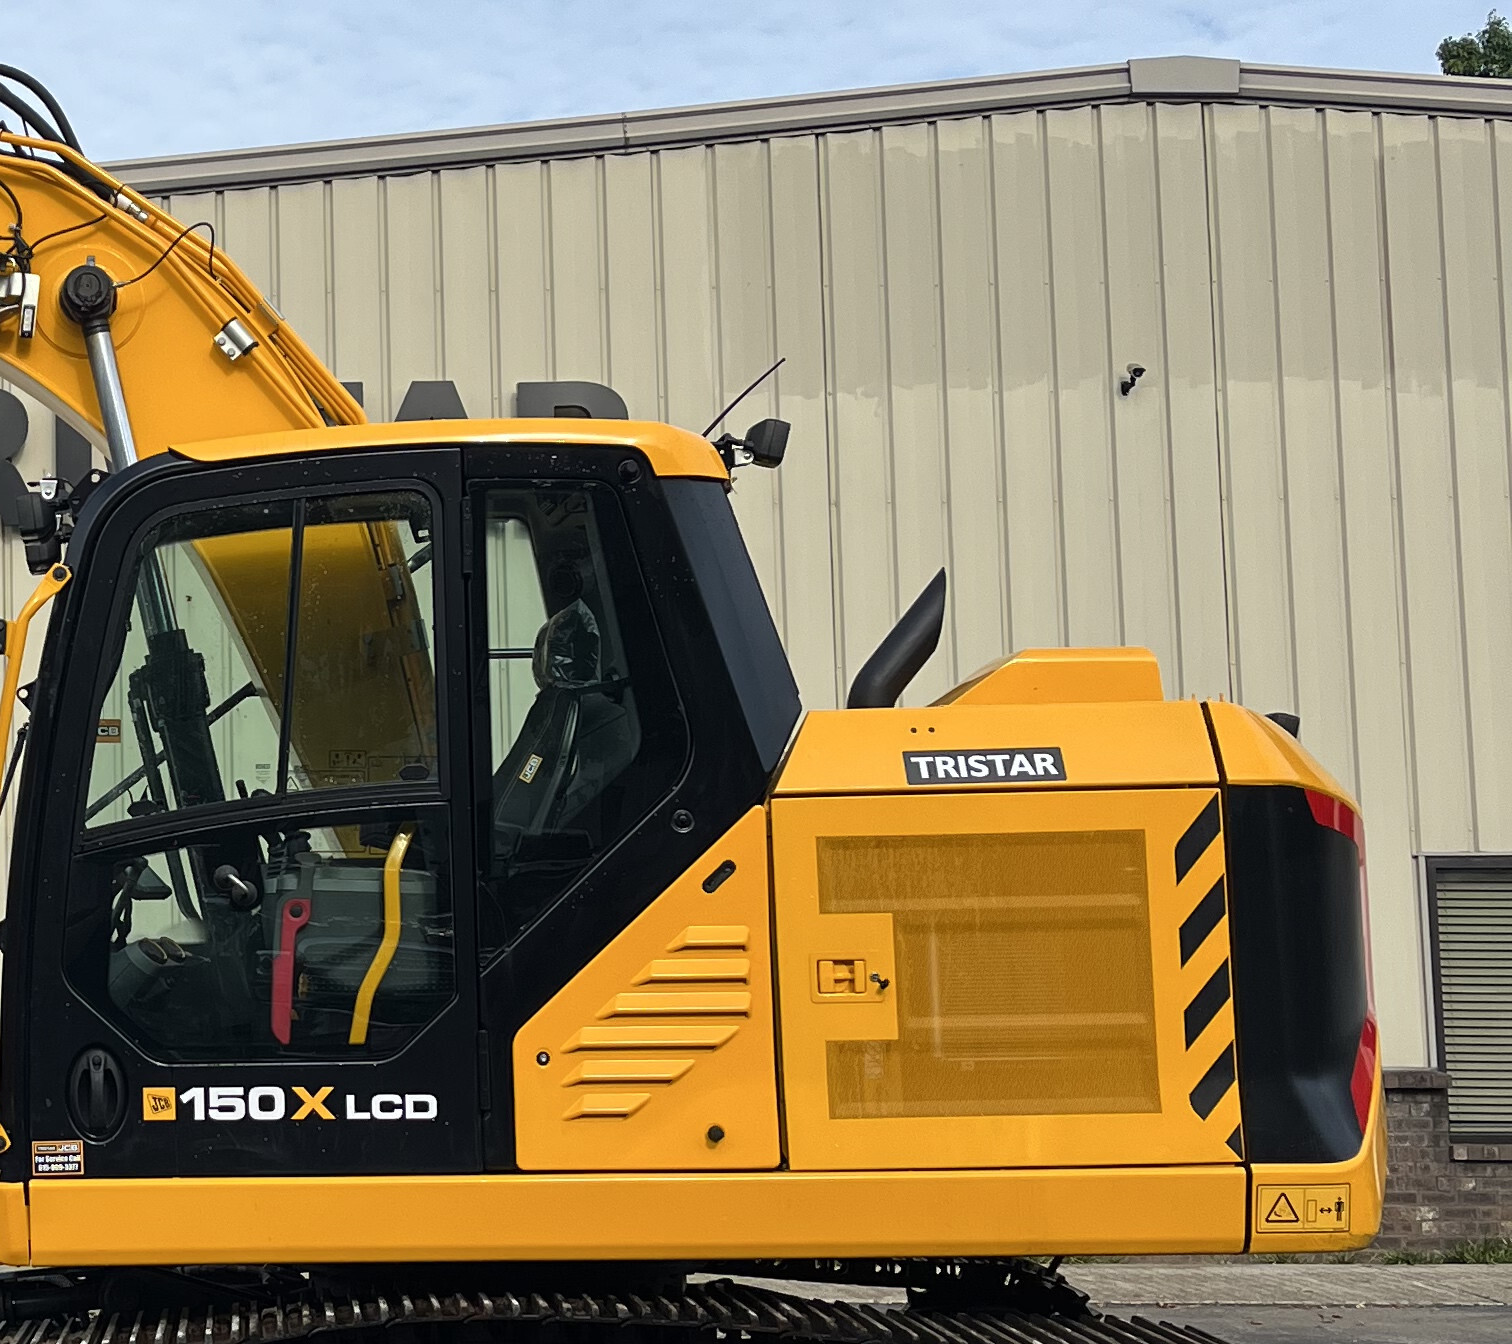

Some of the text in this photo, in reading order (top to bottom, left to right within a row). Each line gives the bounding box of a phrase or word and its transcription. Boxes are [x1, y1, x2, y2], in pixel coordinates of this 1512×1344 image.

[522, 758, 540, 780] JCB
[910, 753, 1059, 779] TRISTAR
[151, 1096, 171, 1111] JCB
[346, 1094, 438, 1121] LCD
